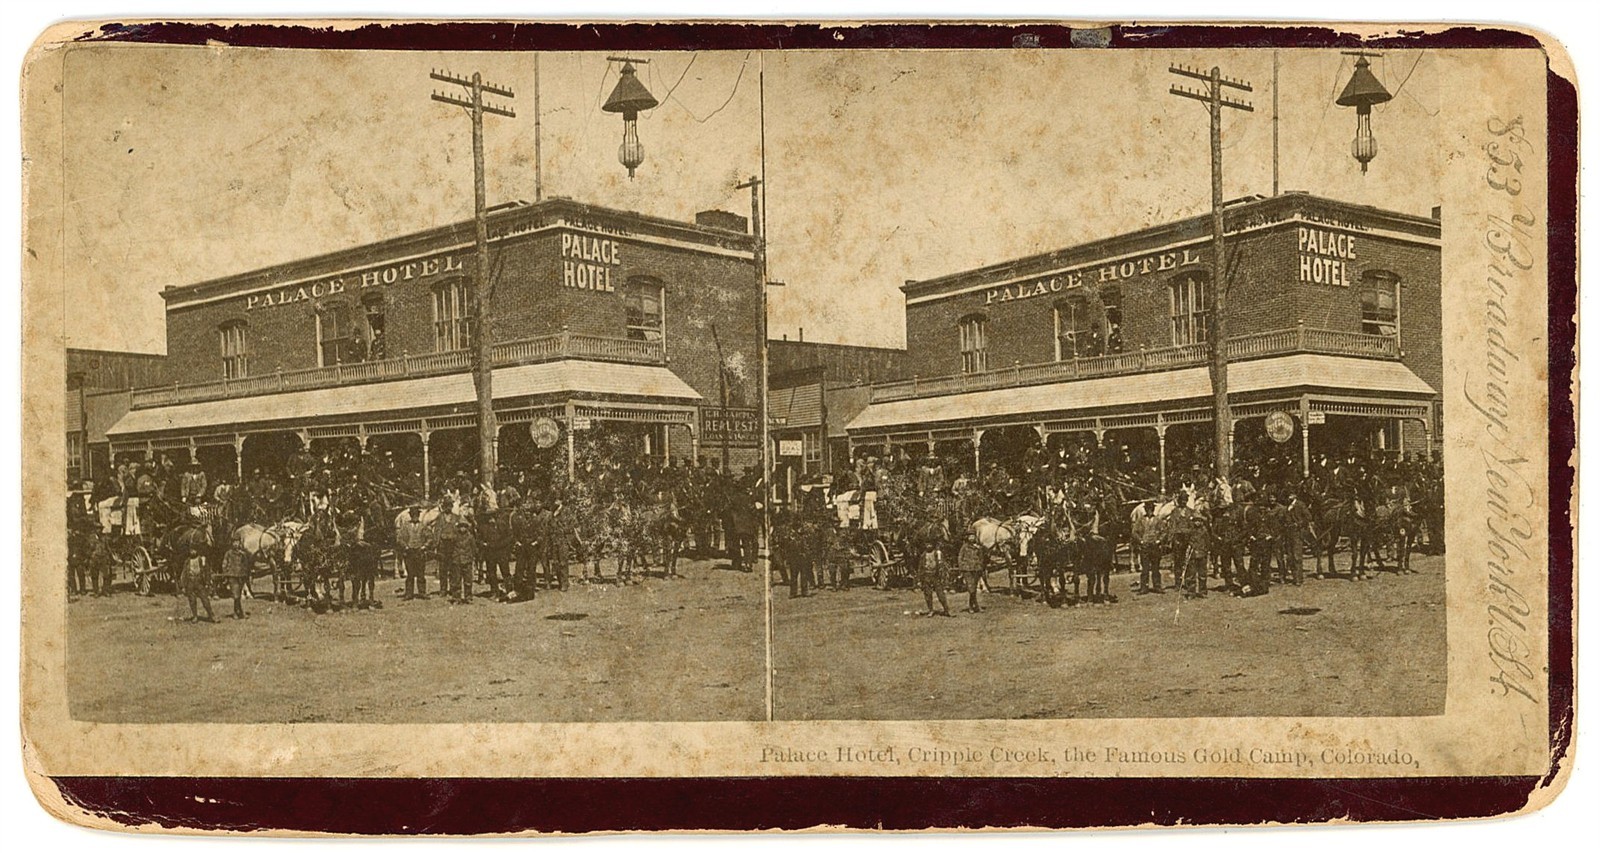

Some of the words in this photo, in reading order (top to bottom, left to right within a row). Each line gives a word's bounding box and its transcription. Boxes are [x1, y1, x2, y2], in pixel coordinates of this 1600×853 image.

[1486, 114, 1534, 196] 853
[562, 233, 621, 265] PALACE
[1298, 228, 1356, 259] PALACE
[246, 277, 345, 310] PALACE
[361, 255, 464, 288] HOTEL
[564, 261, 614, 292] HOTEL
[985, 271, 1083, 304] PALACE
[1099, 250, 1200, 283] HOTEL
[1300, 255, 1350, 287] HOTEL
[1464, 205, 1535, 432] Broadway
[705, 420, 732, 431] REAL
[1480, 424, 1534, 521] New
[1487, 513, 1532, 600] York
